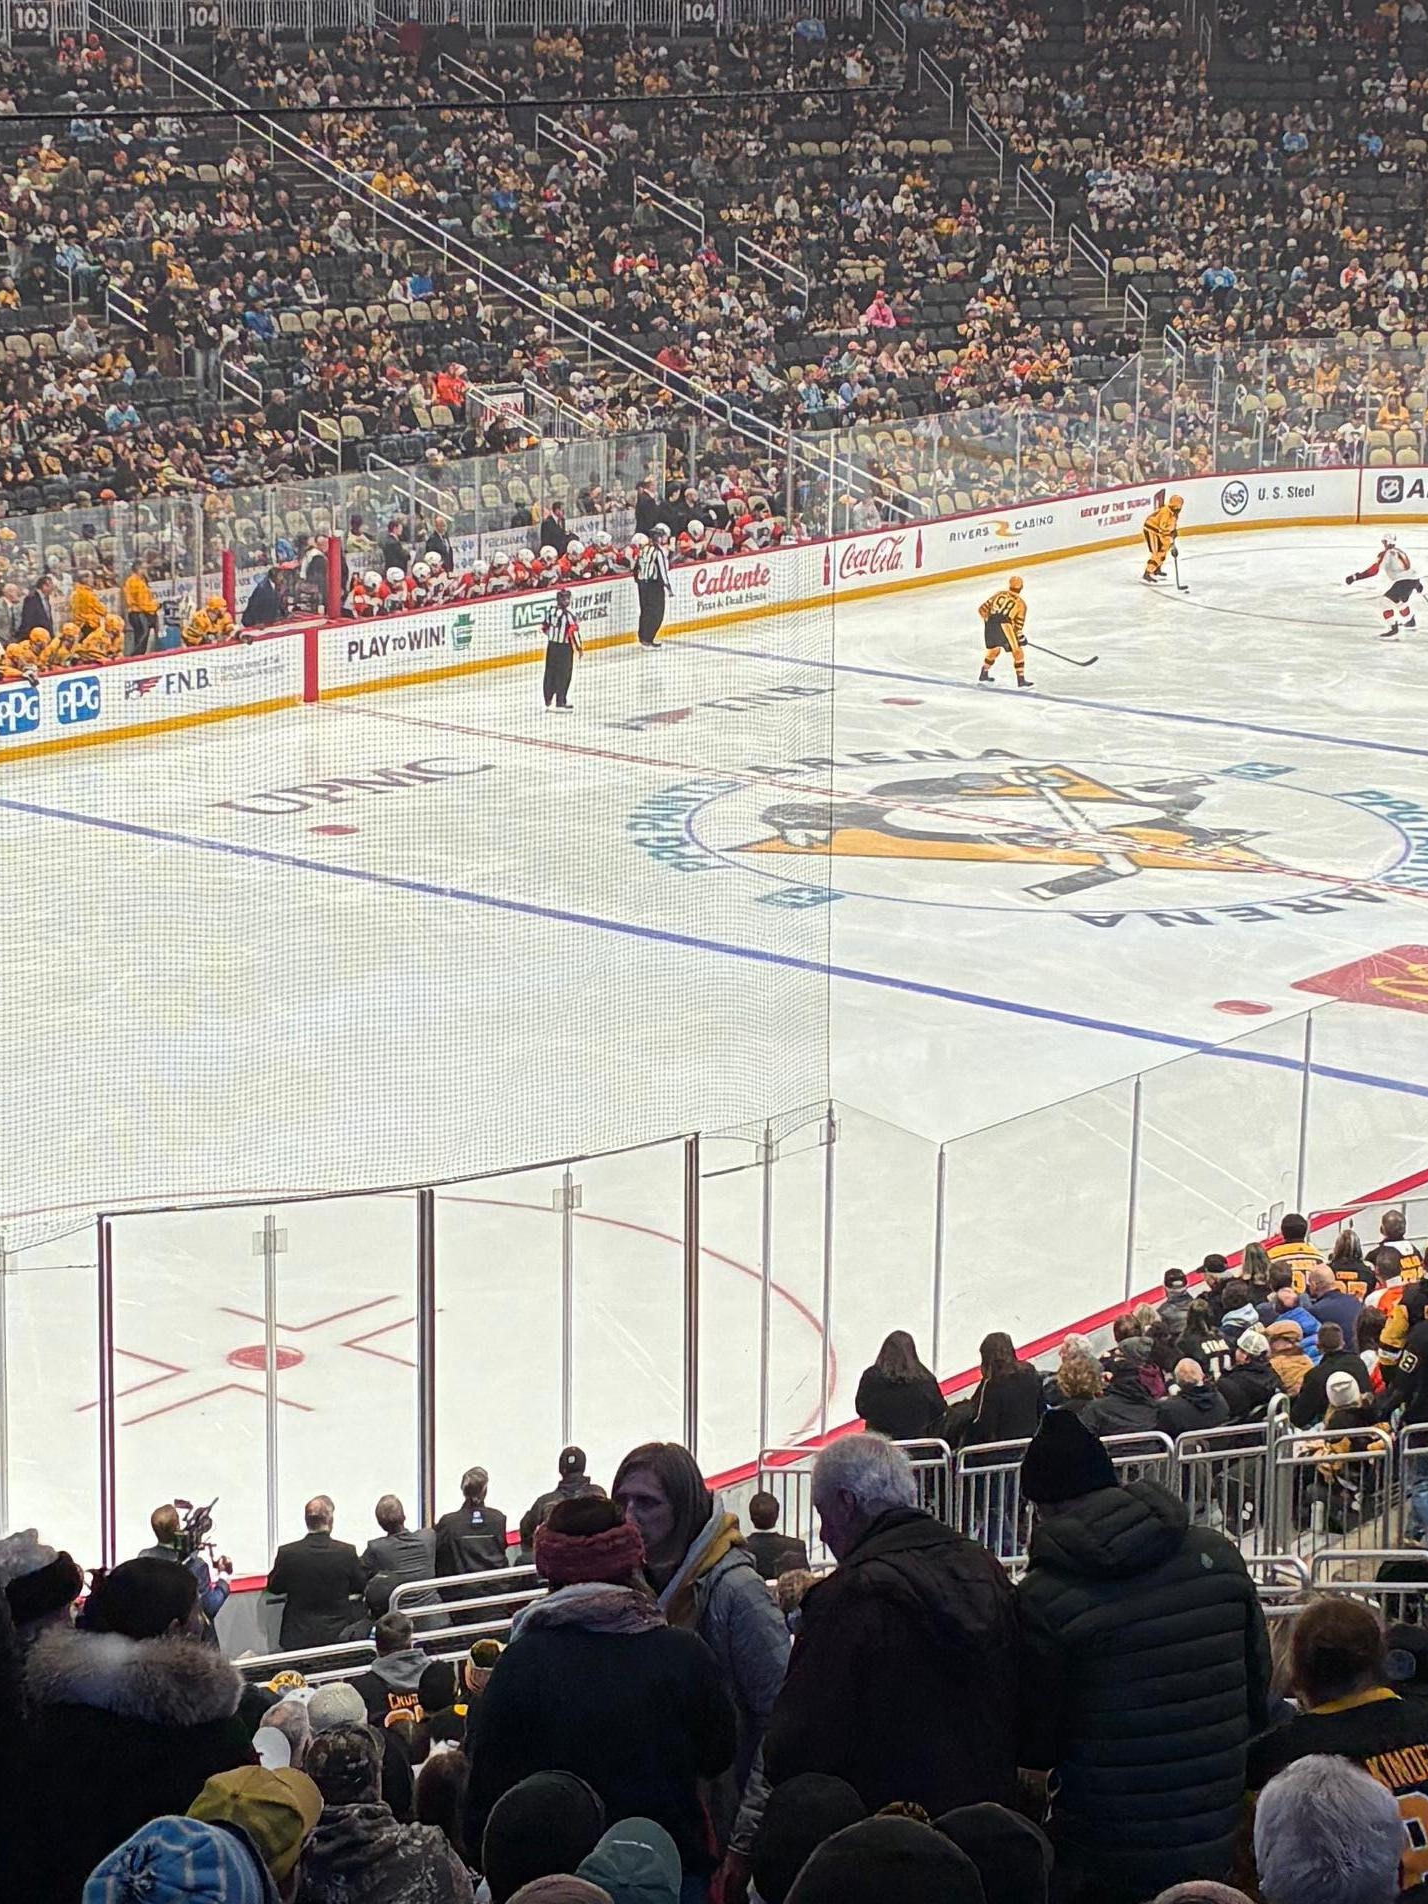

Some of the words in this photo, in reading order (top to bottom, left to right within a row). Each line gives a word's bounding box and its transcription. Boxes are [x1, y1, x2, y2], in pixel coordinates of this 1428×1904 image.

[15, 6, 49, 31] 103
[188, 7, 219, 27] 104
[685, 4, 716, 23] 104
[1287, 485, 1315, 498] Steel
[949, 526, 990, 542] RIVERS
[692, 563, 771, 598] Caliente
[348, 635, 390, 662] PLAY
[408, 624, 446, 651] WIN!
[165, 668, 212, 695] F.N.B.
[58, 679, 100, 720] PPG
